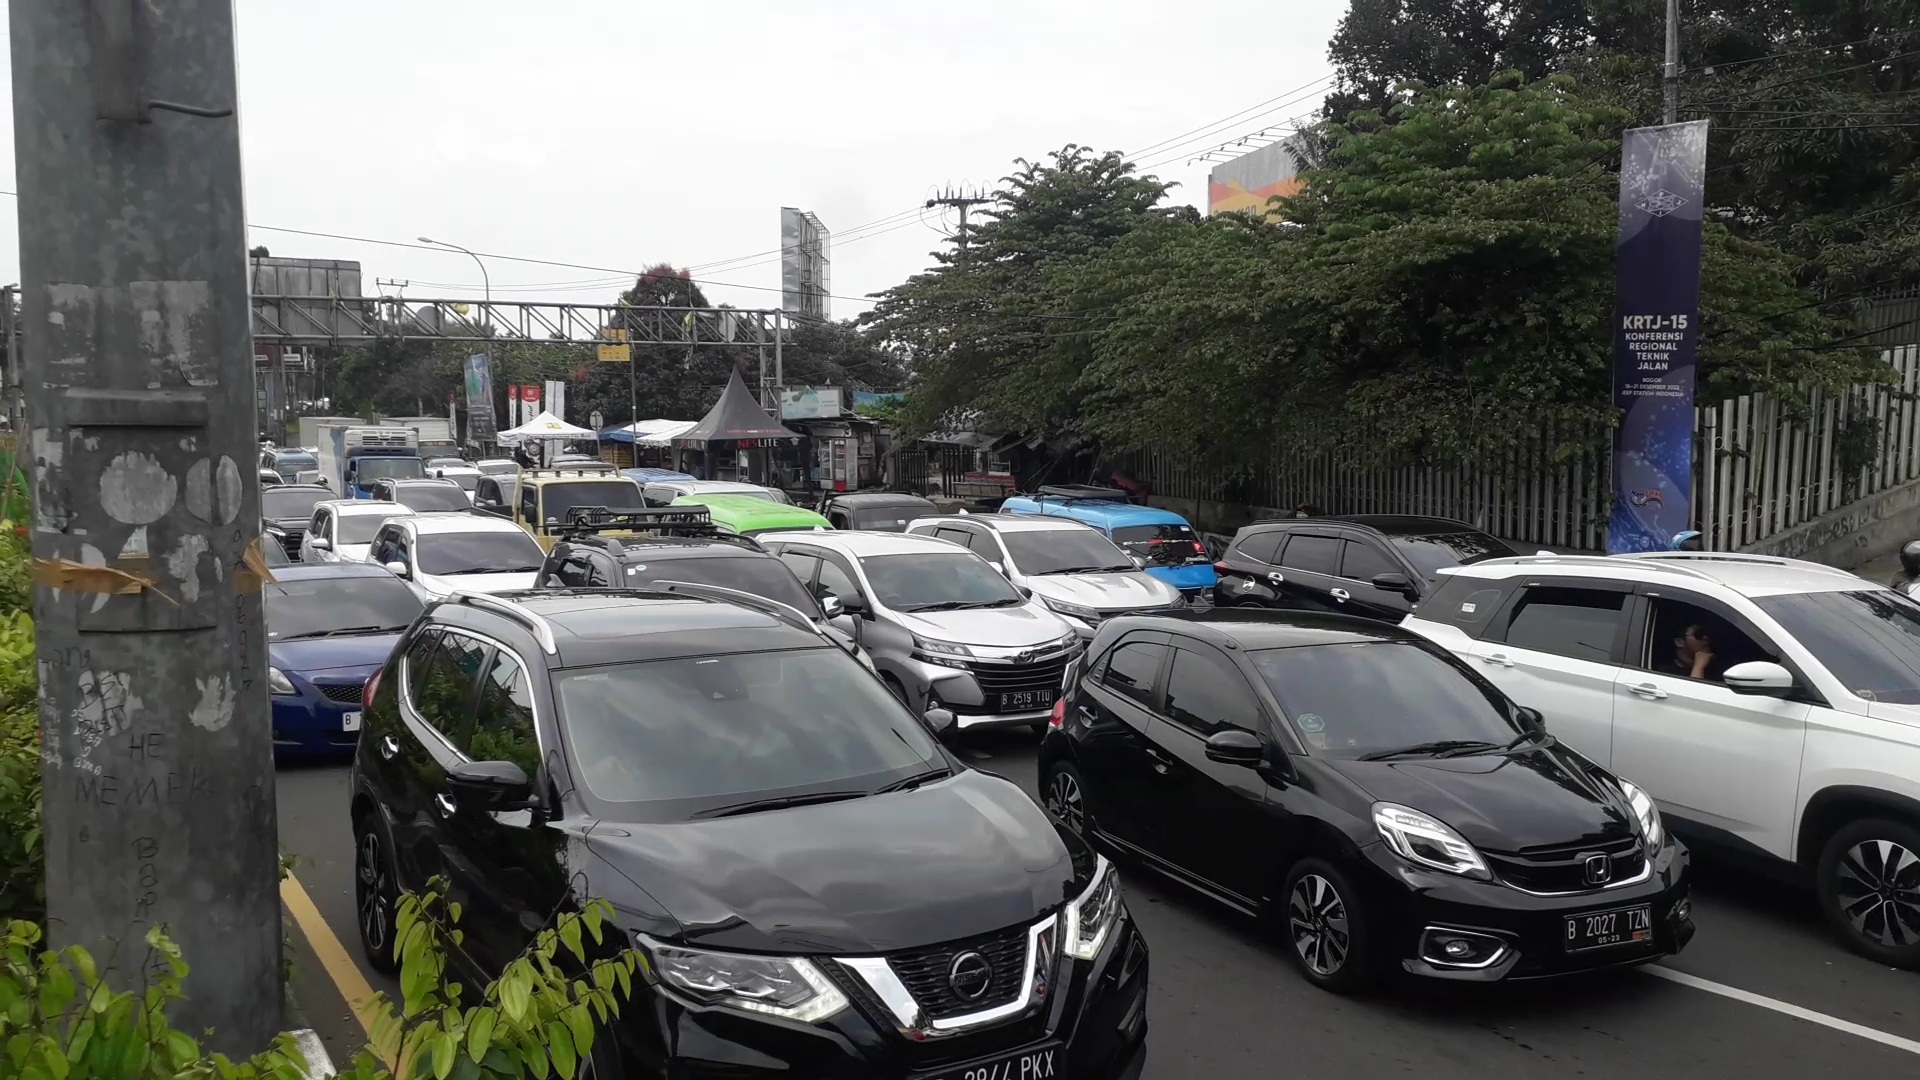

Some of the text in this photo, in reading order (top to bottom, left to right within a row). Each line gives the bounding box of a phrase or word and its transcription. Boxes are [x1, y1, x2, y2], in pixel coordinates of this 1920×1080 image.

[1623, 314, 1688, 330] KRTJ-15
[1625, 332, 1683, 341] KONFERENSI
[1629, 342, 1678, 351] REGIONAL
[1636, 352, 1670, 361] TEKNIK
[1637, 362, 1669, 370] JALAN
[1002, 691, 1050, 705] B 2519 TIU
[346, 714, 352, 725] B
[128, 733, 164, 761] HE
[1568, 909, 1649, 940] B 2027 TZN
[1598, 935, 1620, 943] 05-23
[1021, 1050, 1054, 1080] PKX
